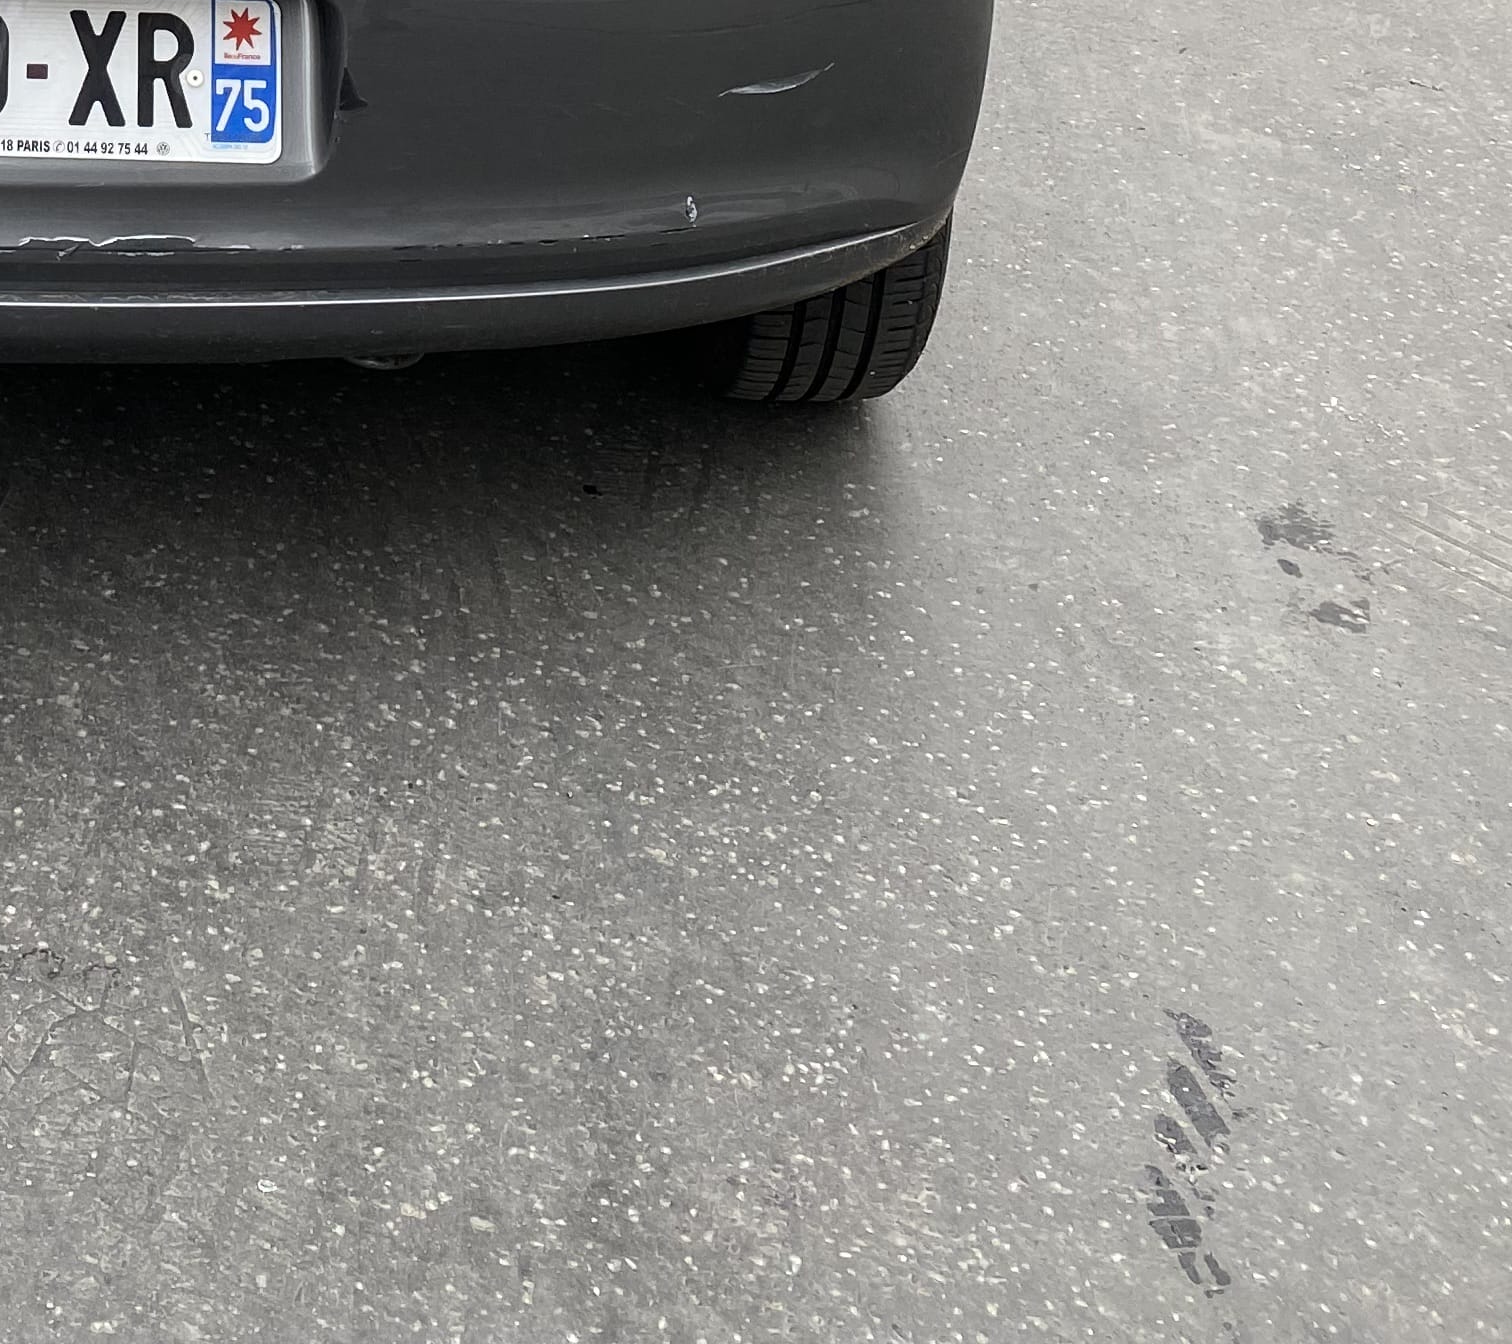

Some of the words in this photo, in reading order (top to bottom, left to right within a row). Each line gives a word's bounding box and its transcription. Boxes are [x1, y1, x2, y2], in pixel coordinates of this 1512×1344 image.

[215, 78, 270, 133] 75
[16, 140, 51, 153] PARIS
[66, 141, 80, 154] 01
[83, 141, 98, 154] 44
[100, 142, 114, 155] 92
[117, 142, 131, 155] 75
[134, 143, 149, 156] 44
